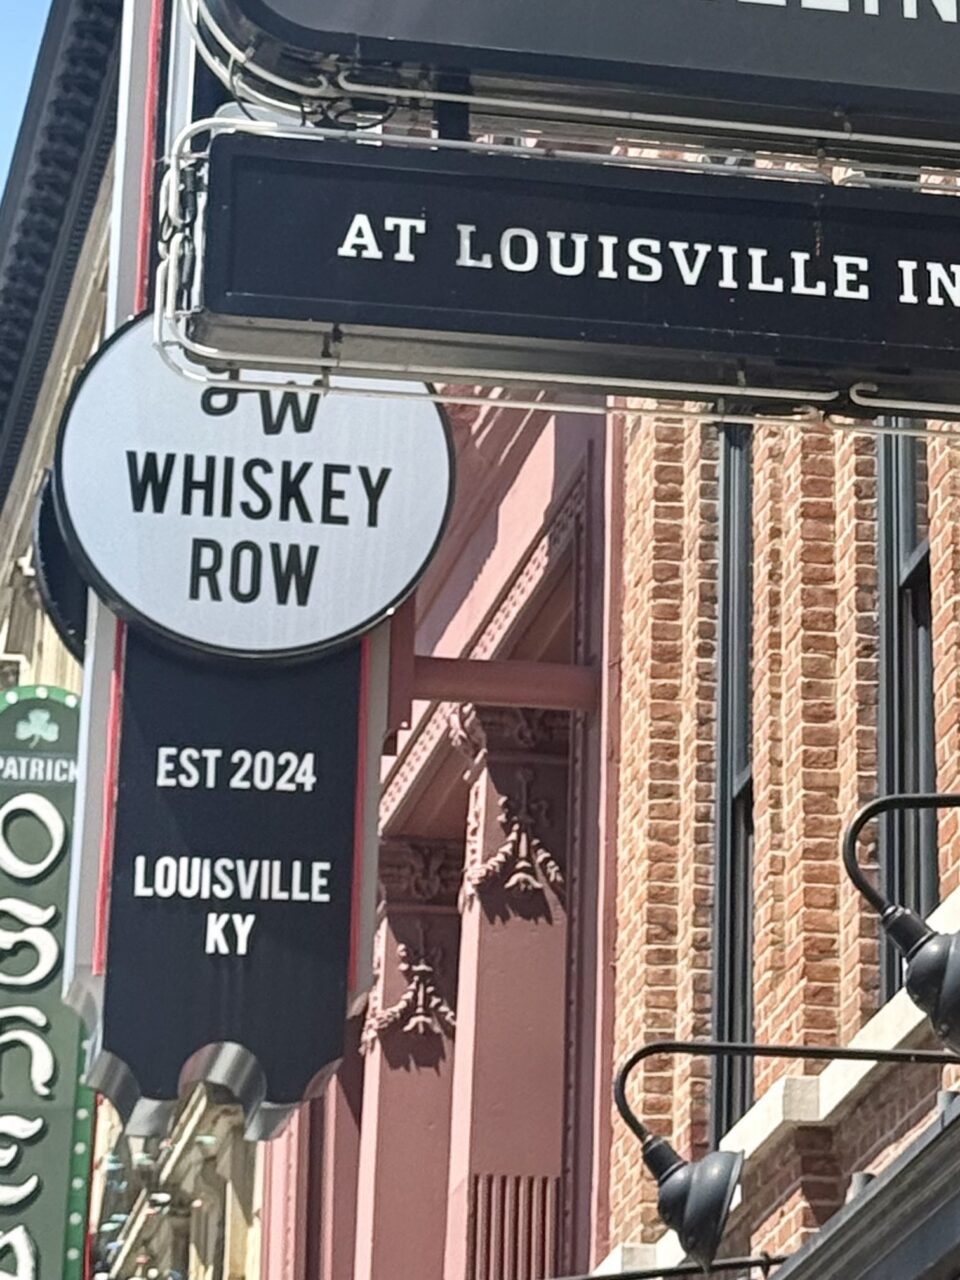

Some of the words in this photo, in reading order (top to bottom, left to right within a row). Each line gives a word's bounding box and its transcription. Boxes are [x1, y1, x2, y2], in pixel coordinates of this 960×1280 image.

[337, 213, 426, 262] AT
[455, 223, 870, 300] LOUISVILLE
[126, 449, 392, 528] WHISKEY
[189, 537, 320, 607] ROW
[0, 755, 79, 783] ATRICK
[156, 746, 222, 789] EST
[229, 749, 317, 792] 2024
[133, 854, 331, 903] LOUISVILLE
[205, 912, 256, 956] KY
